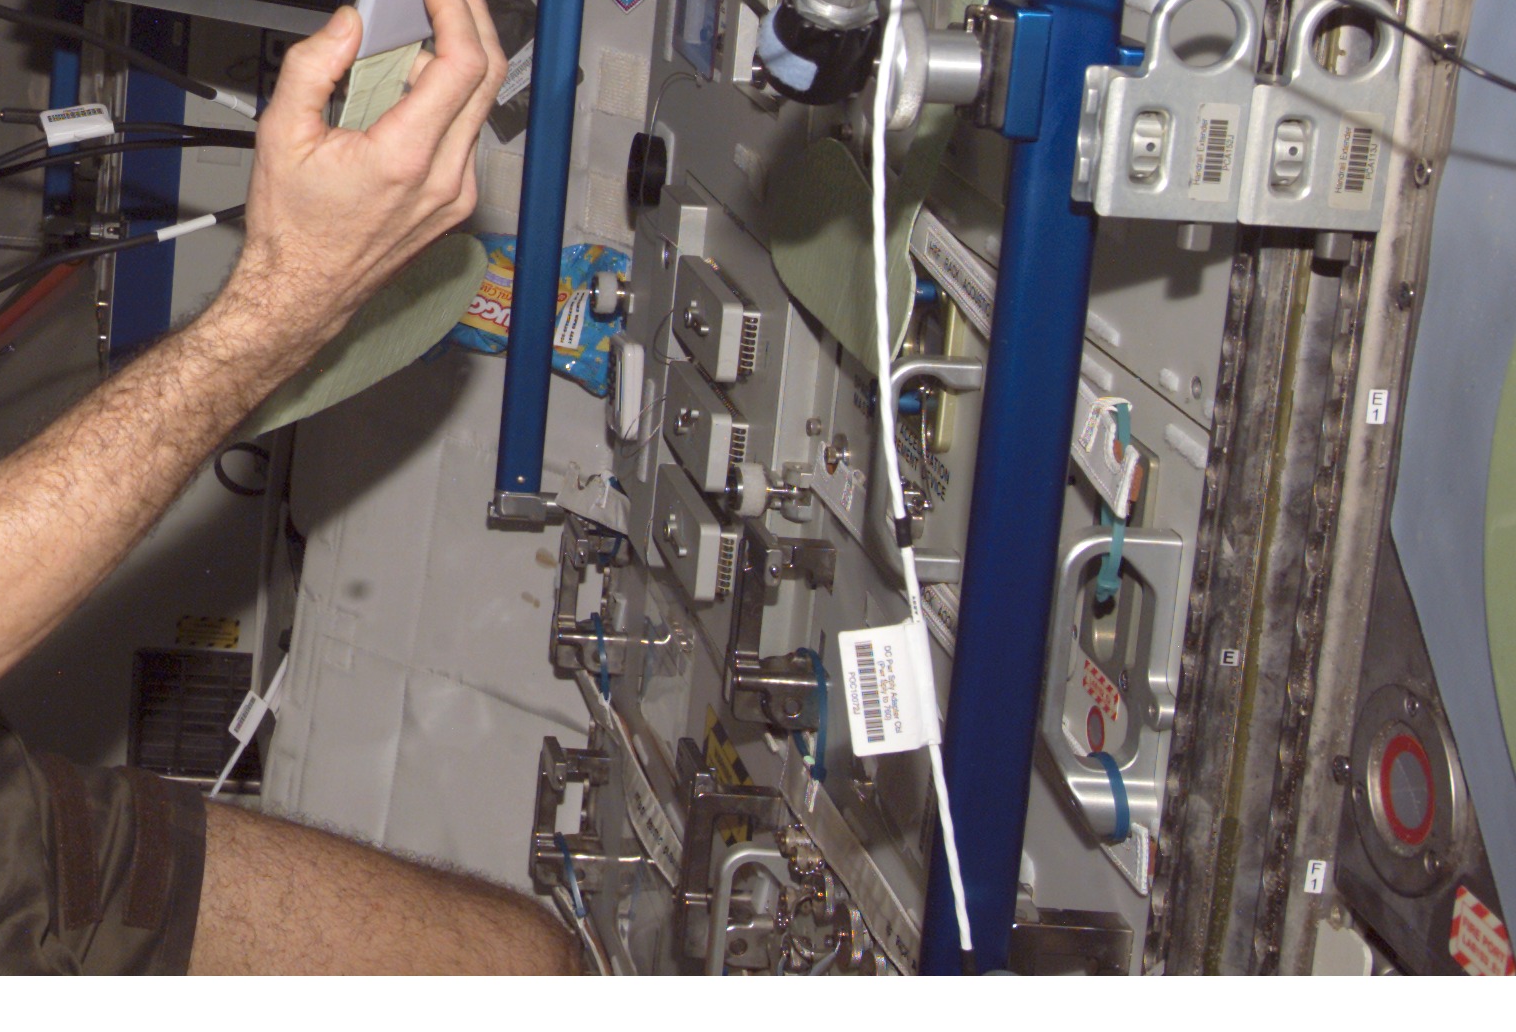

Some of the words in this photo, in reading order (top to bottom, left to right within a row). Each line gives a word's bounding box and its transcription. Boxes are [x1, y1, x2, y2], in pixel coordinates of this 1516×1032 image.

[1196, 119, 1208, 153] Extender
[1334, 161, 1346, 194] Handrail
[1340, 126, 1351, 161] Extender
[1192, 153, 1204, 186] Handrail
[1372, 392, 1383, 406] E
[1373, 408, 1379, 422] 1
[1223, 651, 1235, 665] E
[884, 645, 893, 657] DC
[891, 692, 901, 720] Adapter
[1311, 862, 1322, 874] F
[1311, 878, 1317, 891] 1
